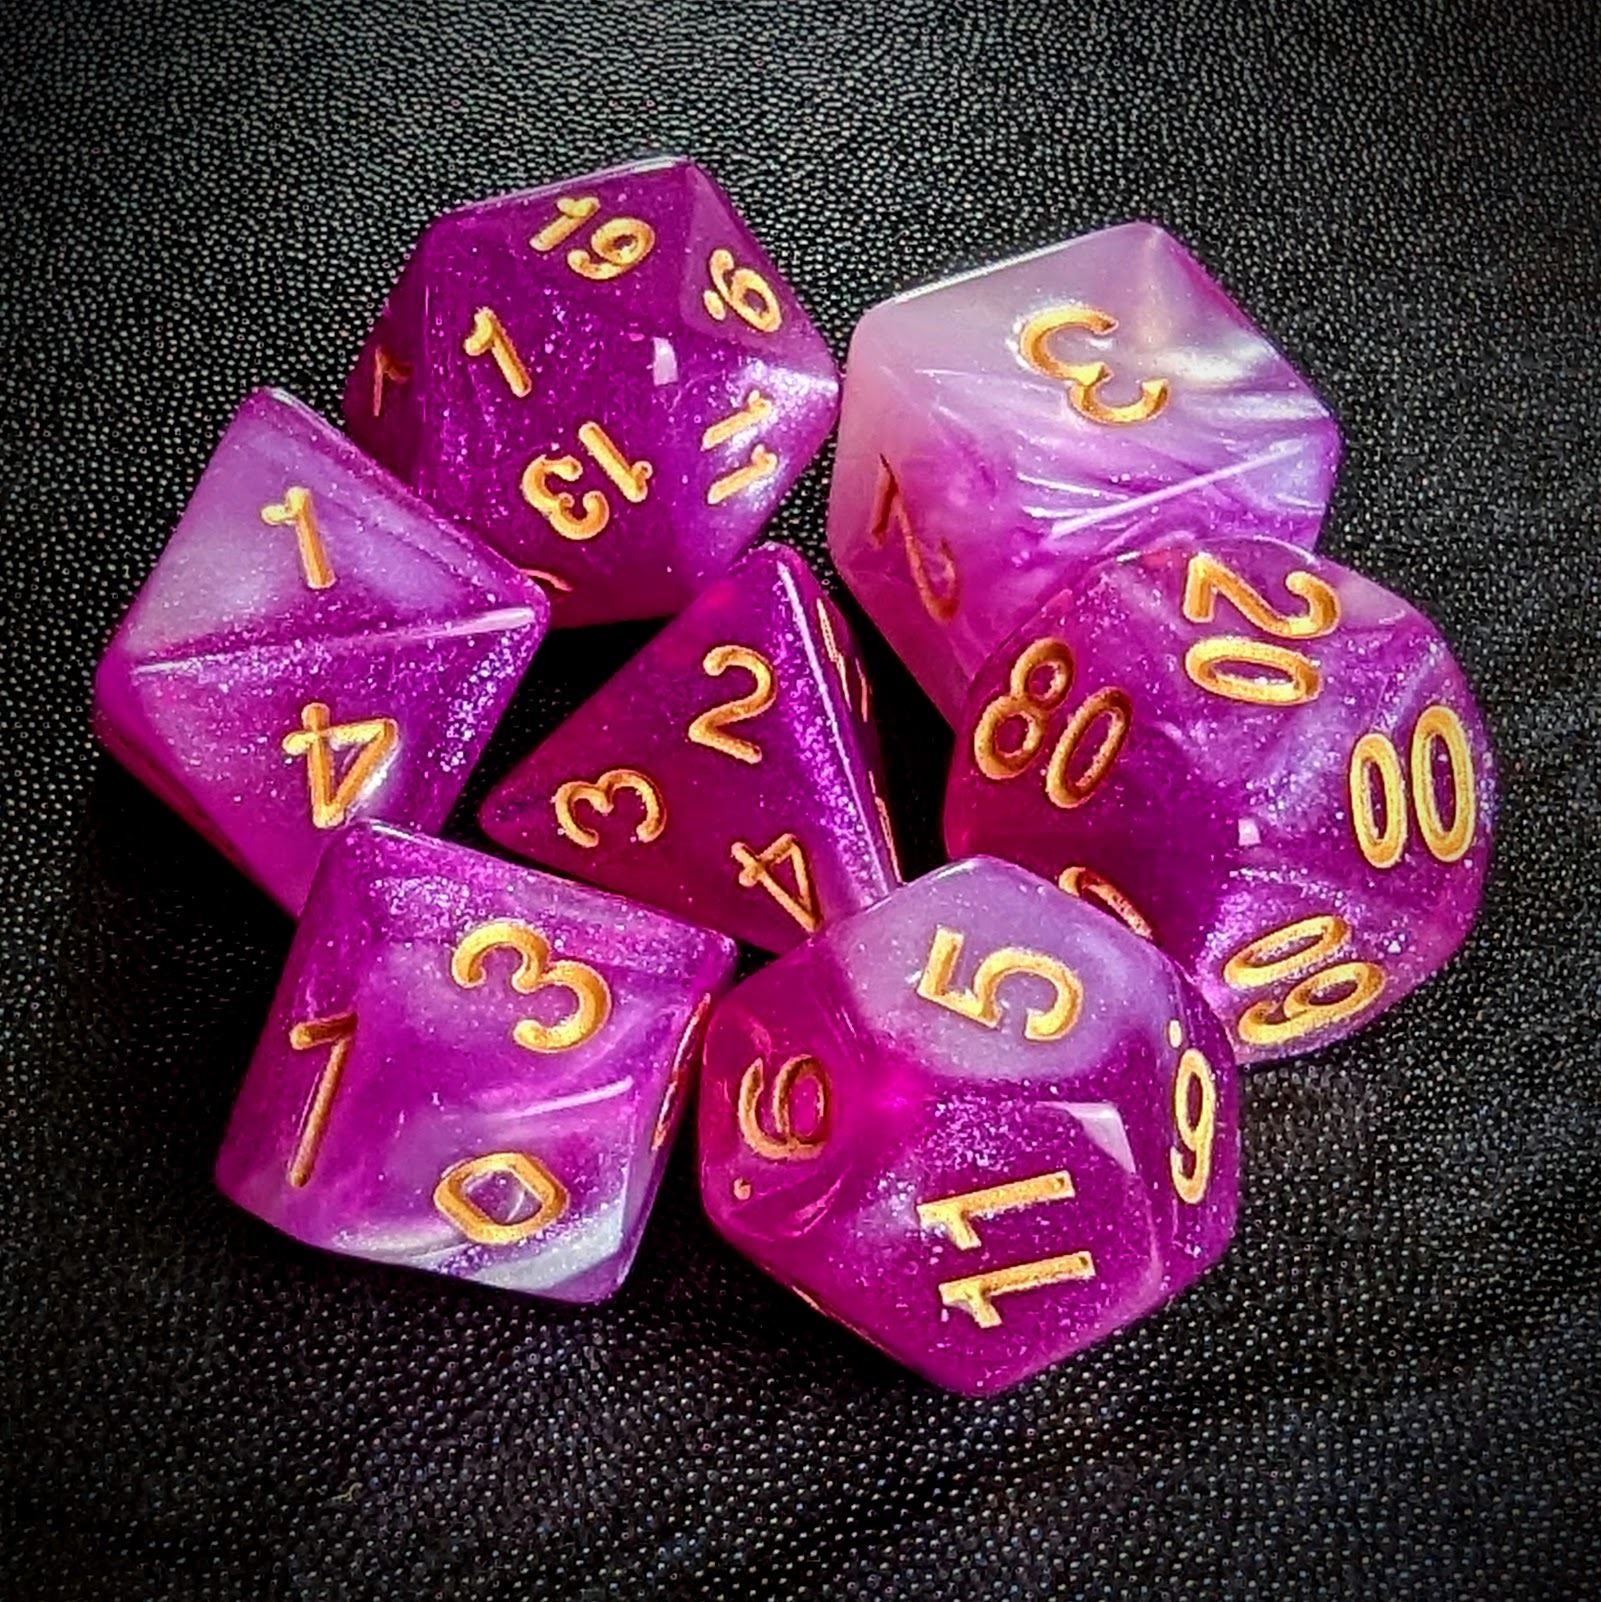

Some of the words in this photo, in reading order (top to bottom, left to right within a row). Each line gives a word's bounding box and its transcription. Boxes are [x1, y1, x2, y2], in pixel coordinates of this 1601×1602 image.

[528, 196, 656, 281] 19
[463, 305, 532, 399] 1
[1018, 305, 1171, 427] 3
[260, 486, 336, 590] 1
[522, 421, 654, 541] 13
[1182, 552, 1343, 706] 20
[688, 644, 777, 764] 2
[973, 636, 1131, 810] 80
[281, 702, 399, 829] 4
[550, 768, 667, 849] 3
[1347, 704, 1477, 870] 00
[731, 832, 820, 933] 4
[451, 917, 613, 1054] 3
[916, 924, 1085, 1042] 5
[432, 1152, 571, 1245] 0
[915, 1168, 1097, 1330] 11
